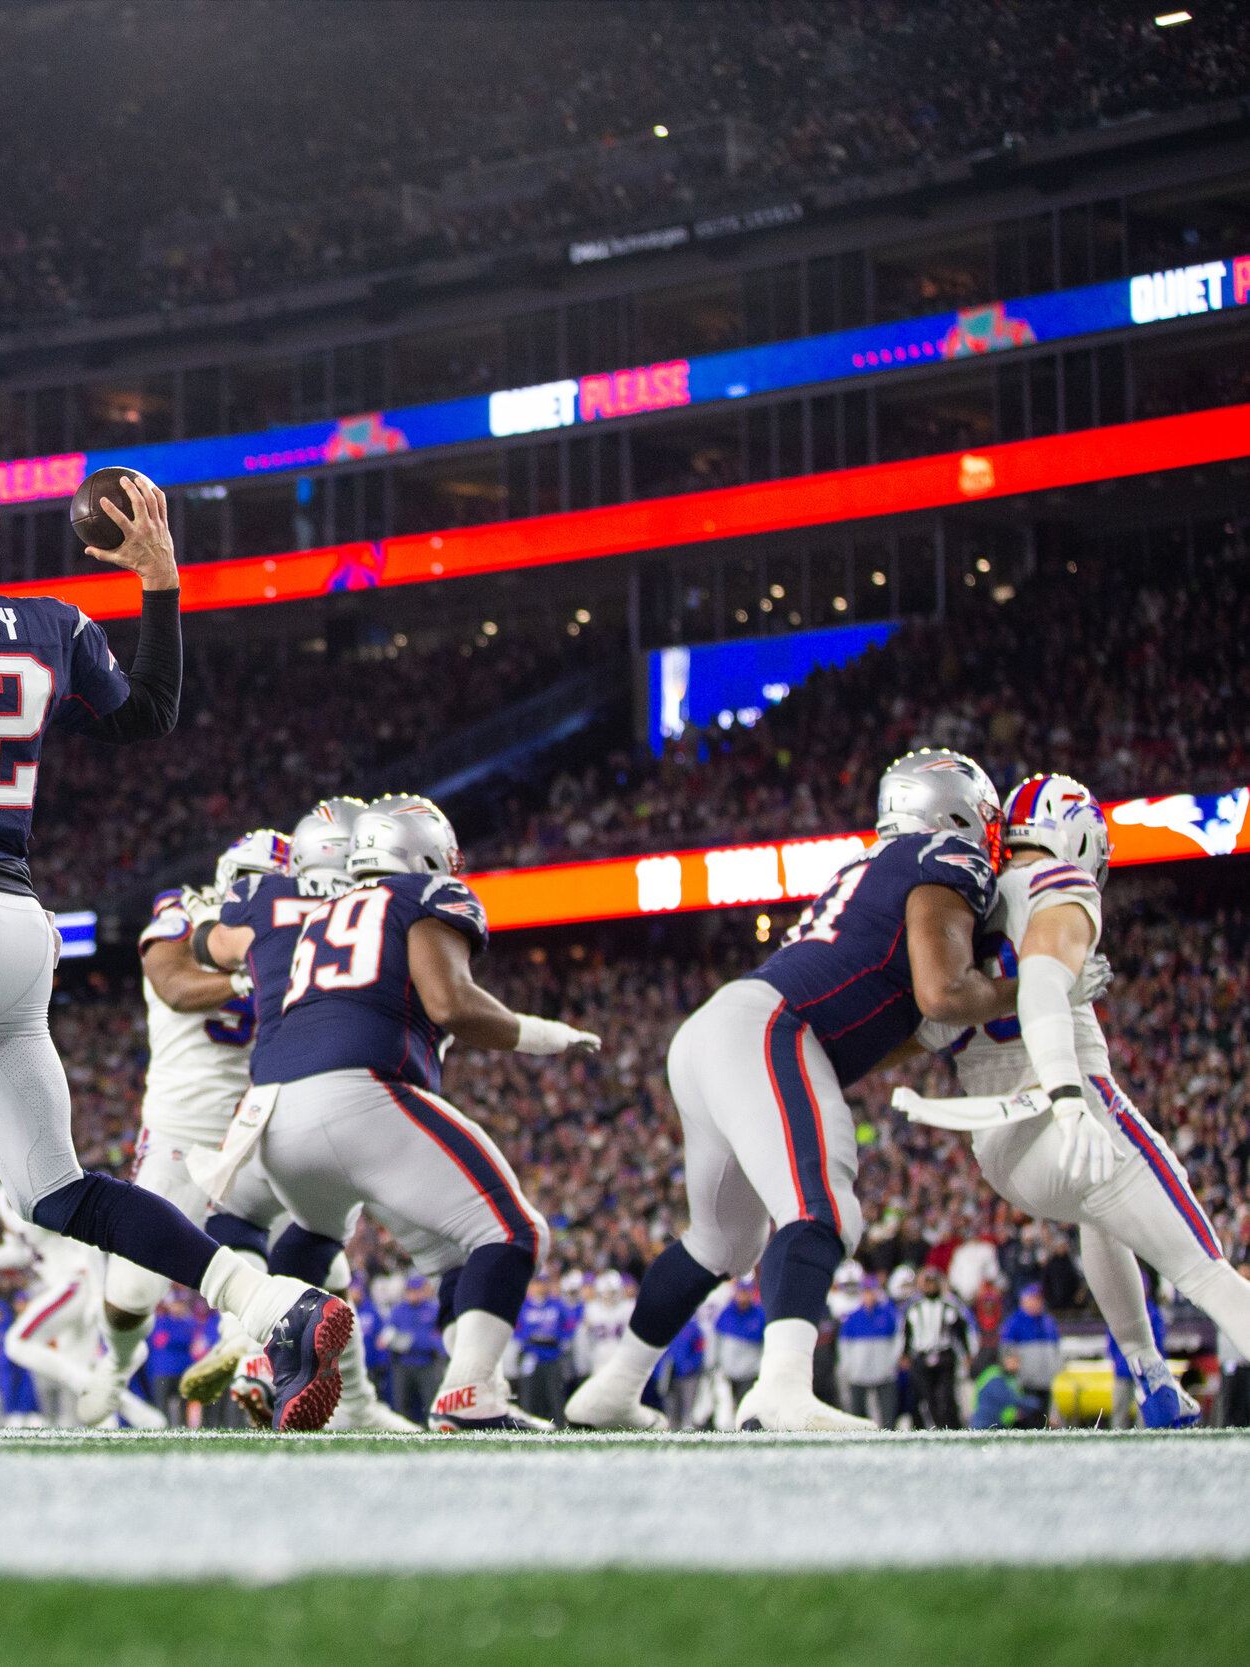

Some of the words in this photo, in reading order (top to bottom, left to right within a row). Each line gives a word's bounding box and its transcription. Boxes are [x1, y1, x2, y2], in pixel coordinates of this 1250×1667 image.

[1130, 261, 1226, 324] QUIET
[579, 358, 690, 421] PLEASE
[436, 1385, 477, 1416] NIKE
